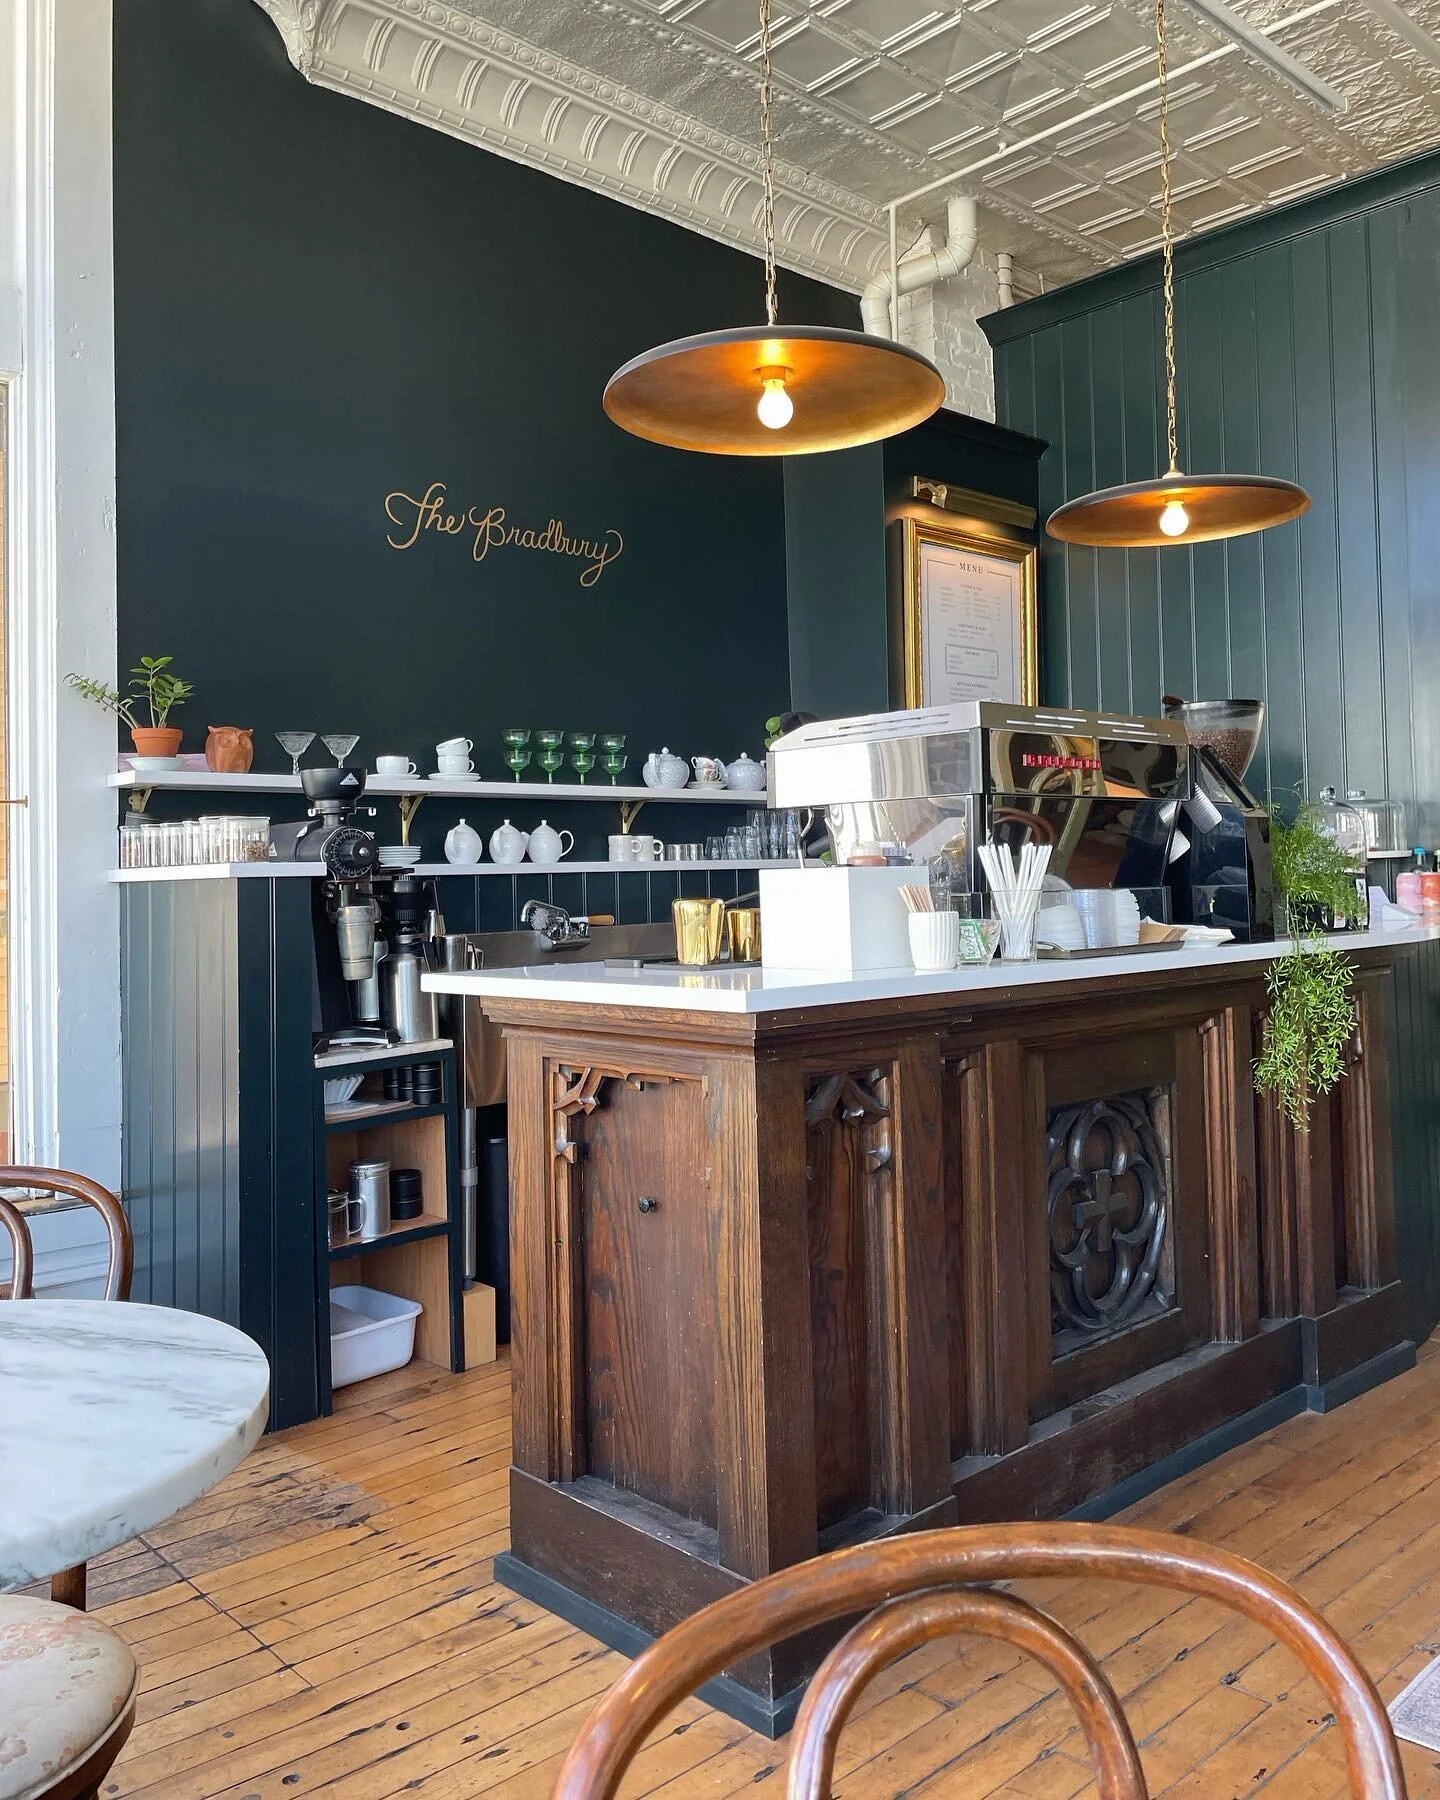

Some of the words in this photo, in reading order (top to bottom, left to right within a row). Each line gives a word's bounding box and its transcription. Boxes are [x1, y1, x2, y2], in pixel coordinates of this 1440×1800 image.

[384, 482, 465, 550] The
[468, 506, 623, 587] Bradbury
[959, 562, 983, 574] MENU
